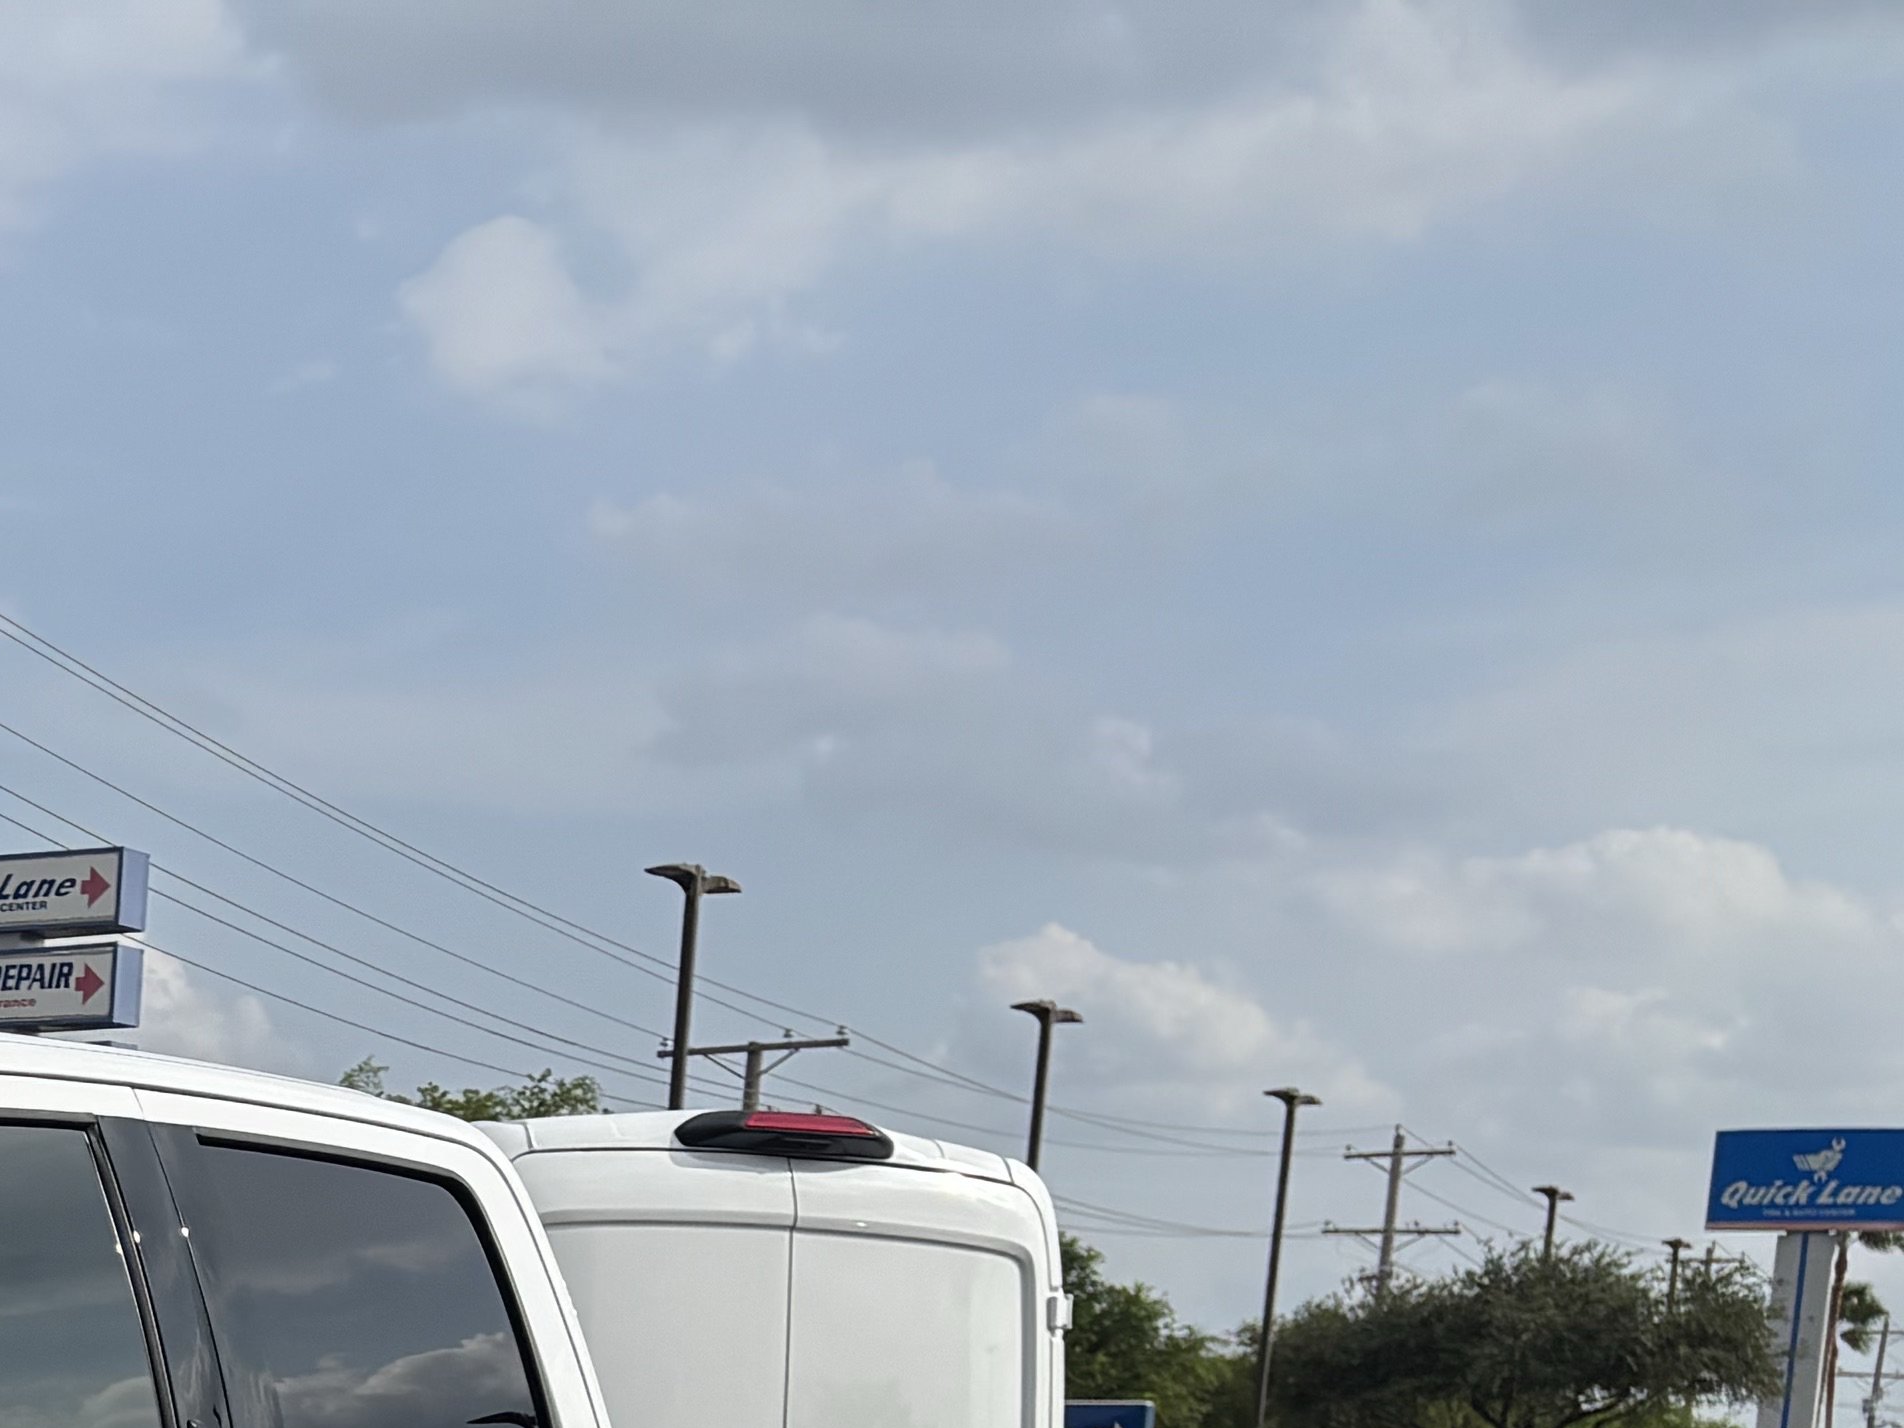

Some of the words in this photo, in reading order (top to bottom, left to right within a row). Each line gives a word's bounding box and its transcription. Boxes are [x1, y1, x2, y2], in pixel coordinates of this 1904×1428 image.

[0, 900, 48, 914] CENTER
[1720, 1179, 1817, 1209] Quick
[1816, 1179, 1904, 1206] Lane
